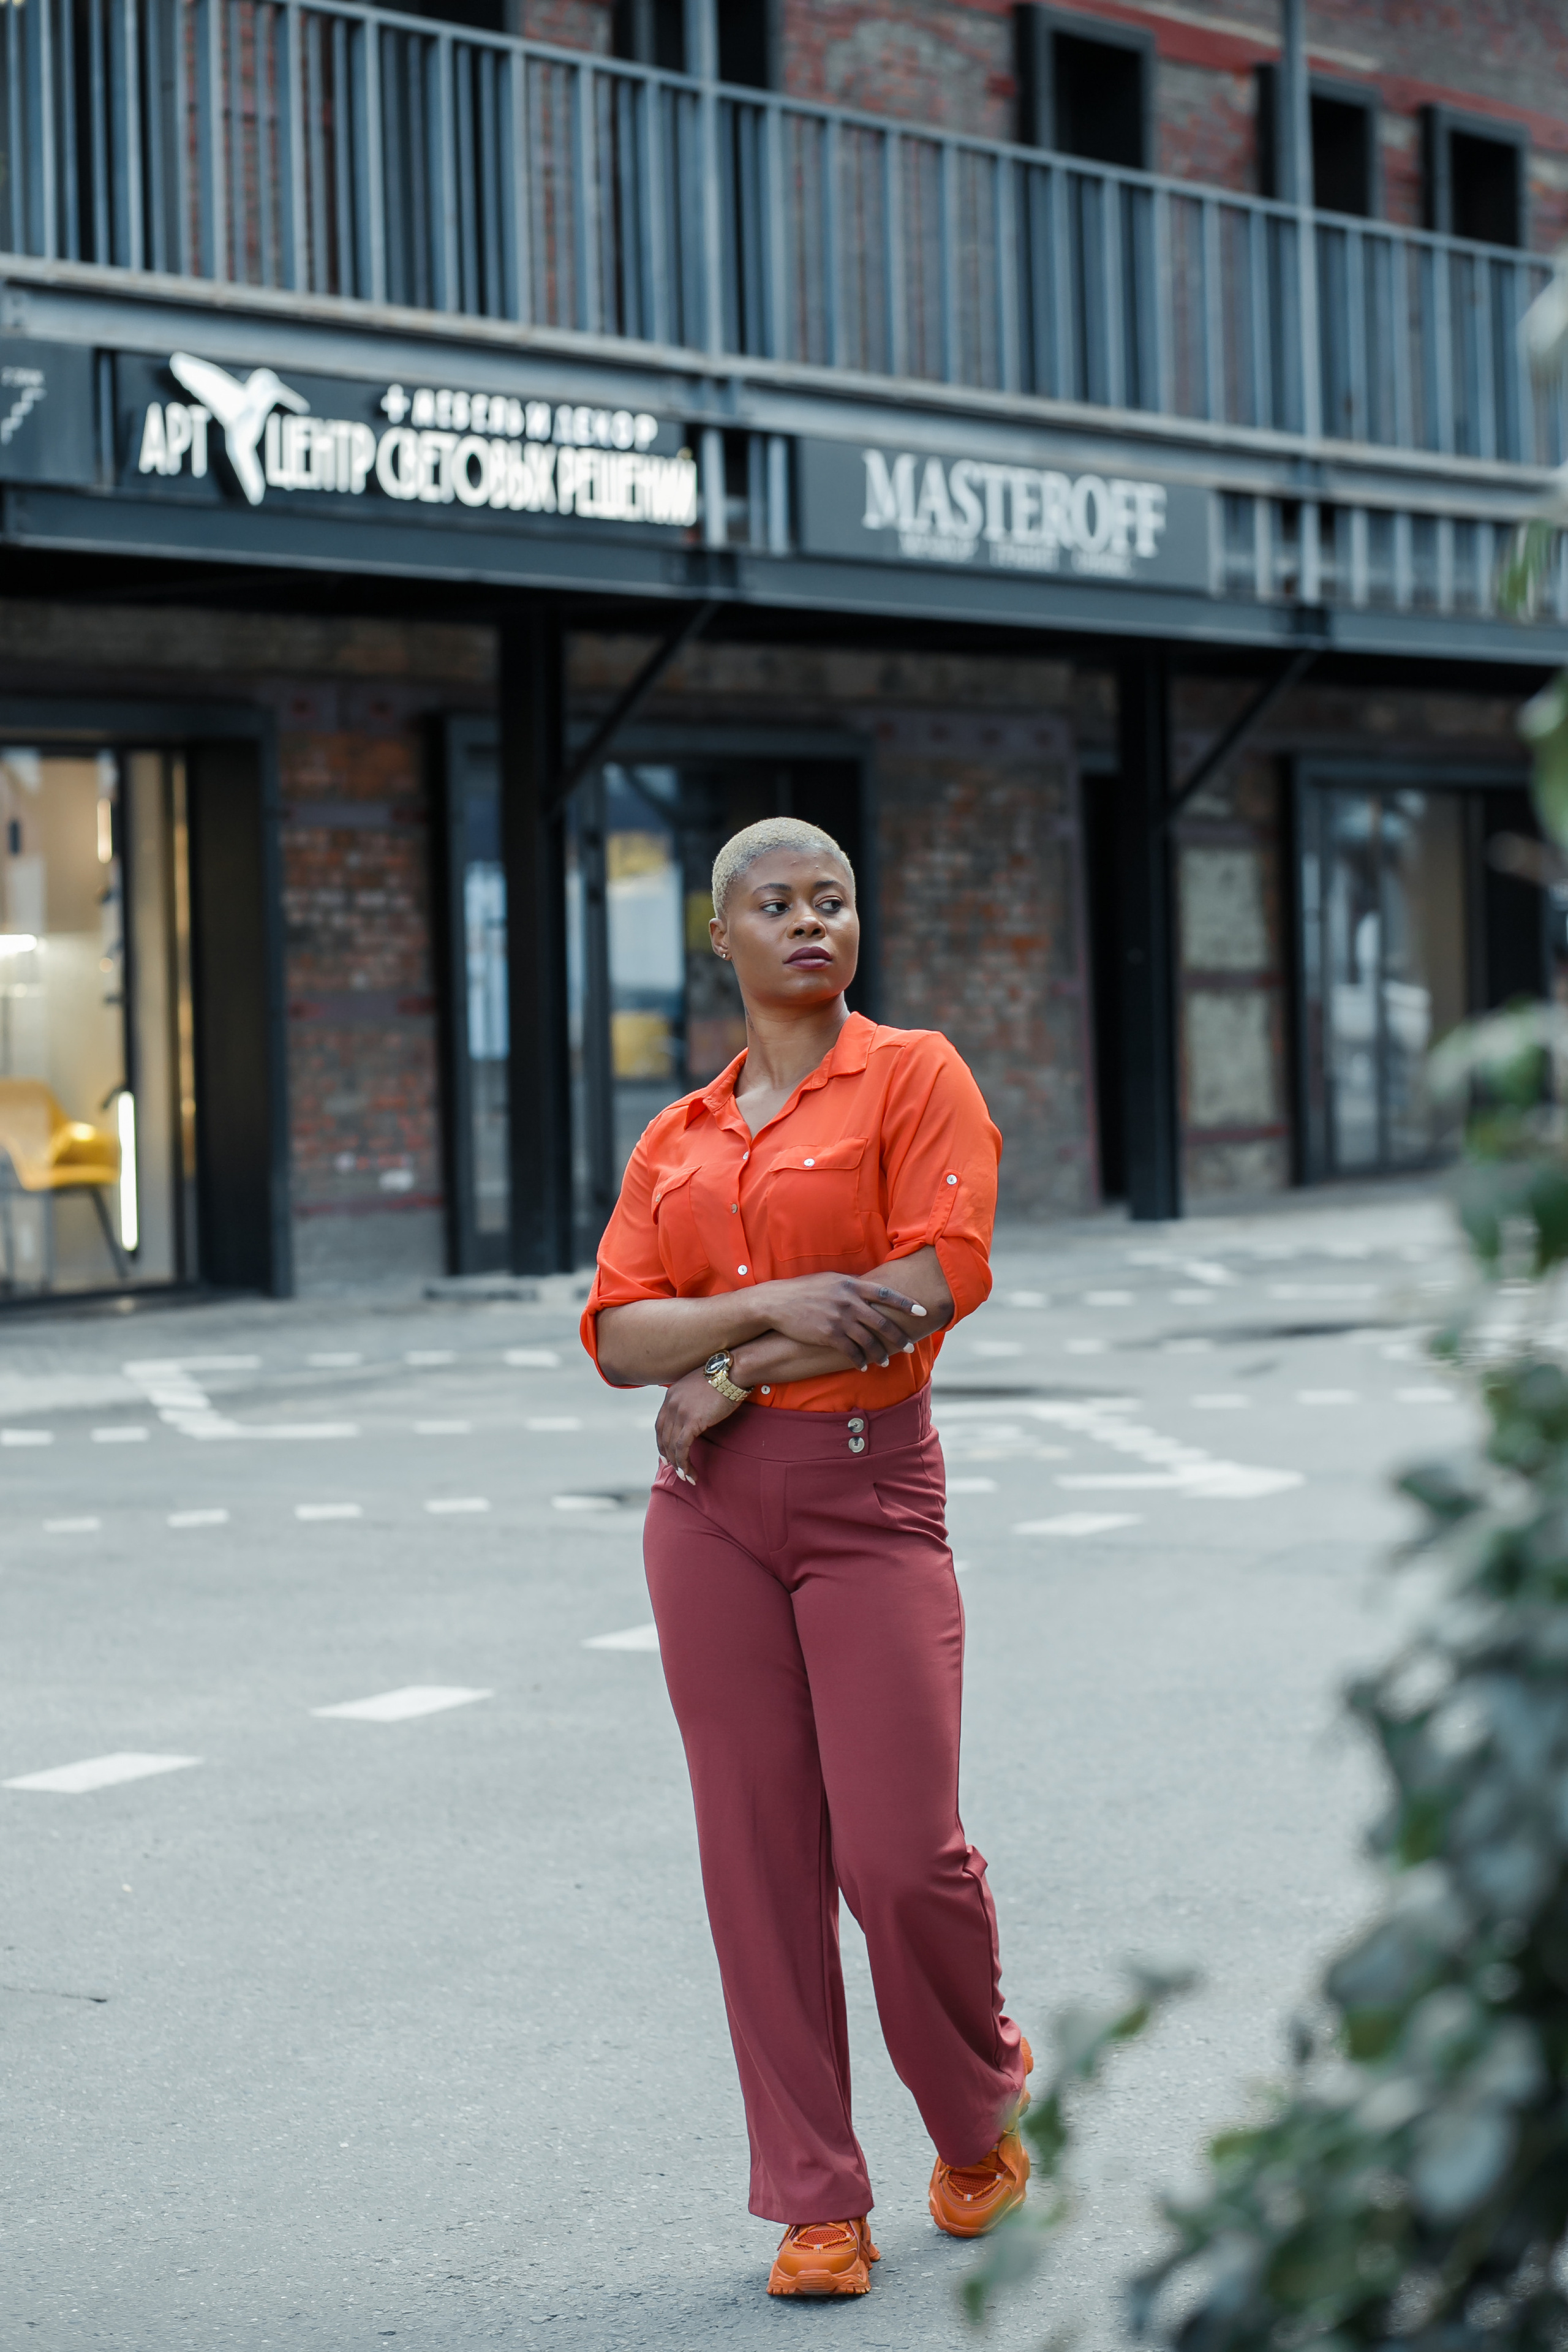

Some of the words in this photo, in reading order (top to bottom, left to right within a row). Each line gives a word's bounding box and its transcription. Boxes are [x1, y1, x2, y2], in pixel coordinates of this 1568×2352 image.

[138, 401, 212, 478] АРТ
[264, 412, 376, 494] ЦЕНТР
[862, 448, 1167, 559] MASTEROFF
